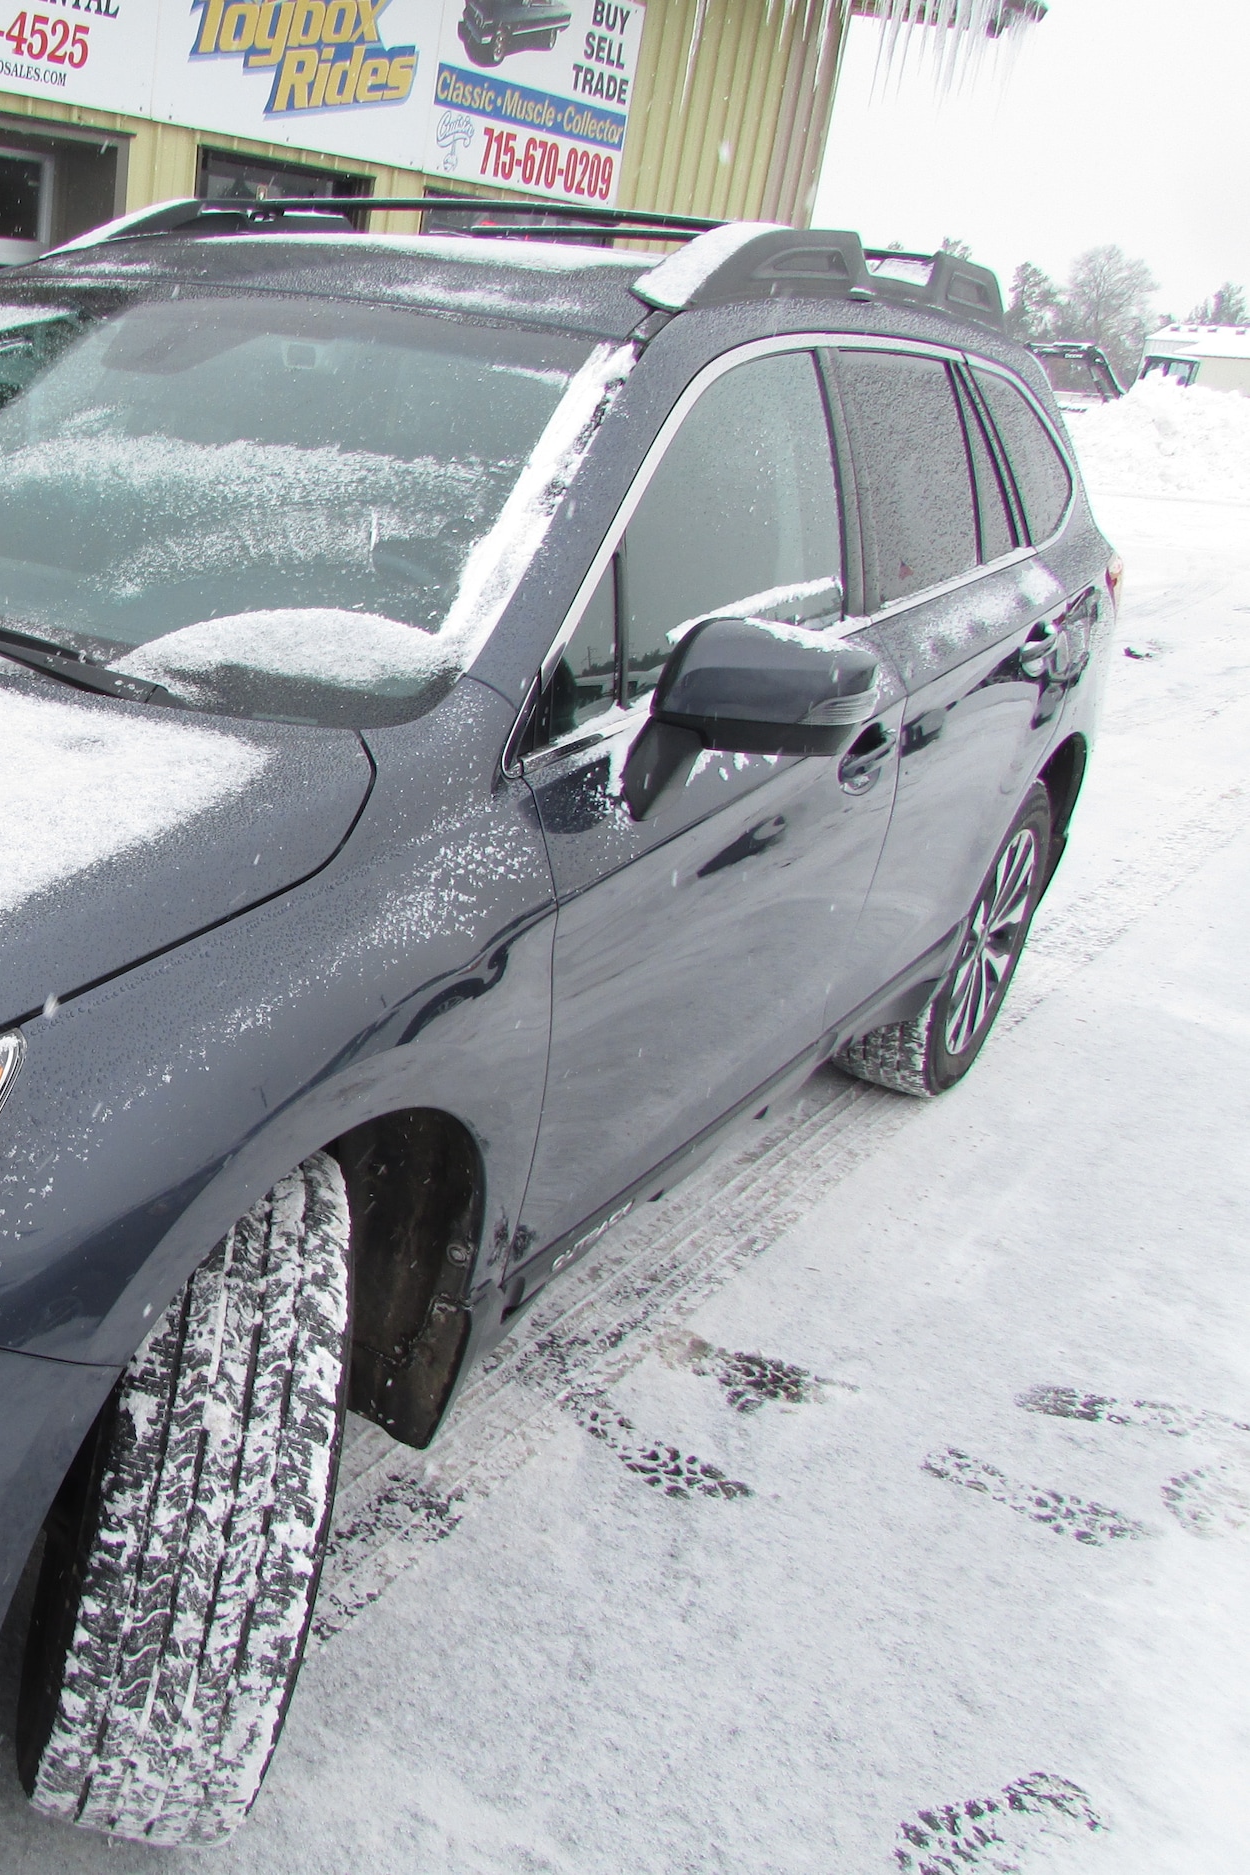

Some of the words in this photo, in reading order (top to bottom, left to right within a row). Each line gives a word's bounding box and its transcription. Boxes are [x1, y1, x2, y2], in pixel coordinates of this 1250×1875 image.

[592, 0, 630, 35] BUY
[271, 43, 417, 112] Rides
[583, 32, 626, 70] SELL
[436, 70, 495, 112] Classic
[501, 88, 554, 128] Muscle
[563, 105, 623, 145] Collector
[572, 64, 629, 105] TRADE
[480, 127, 614, 200] 715-670-0209
